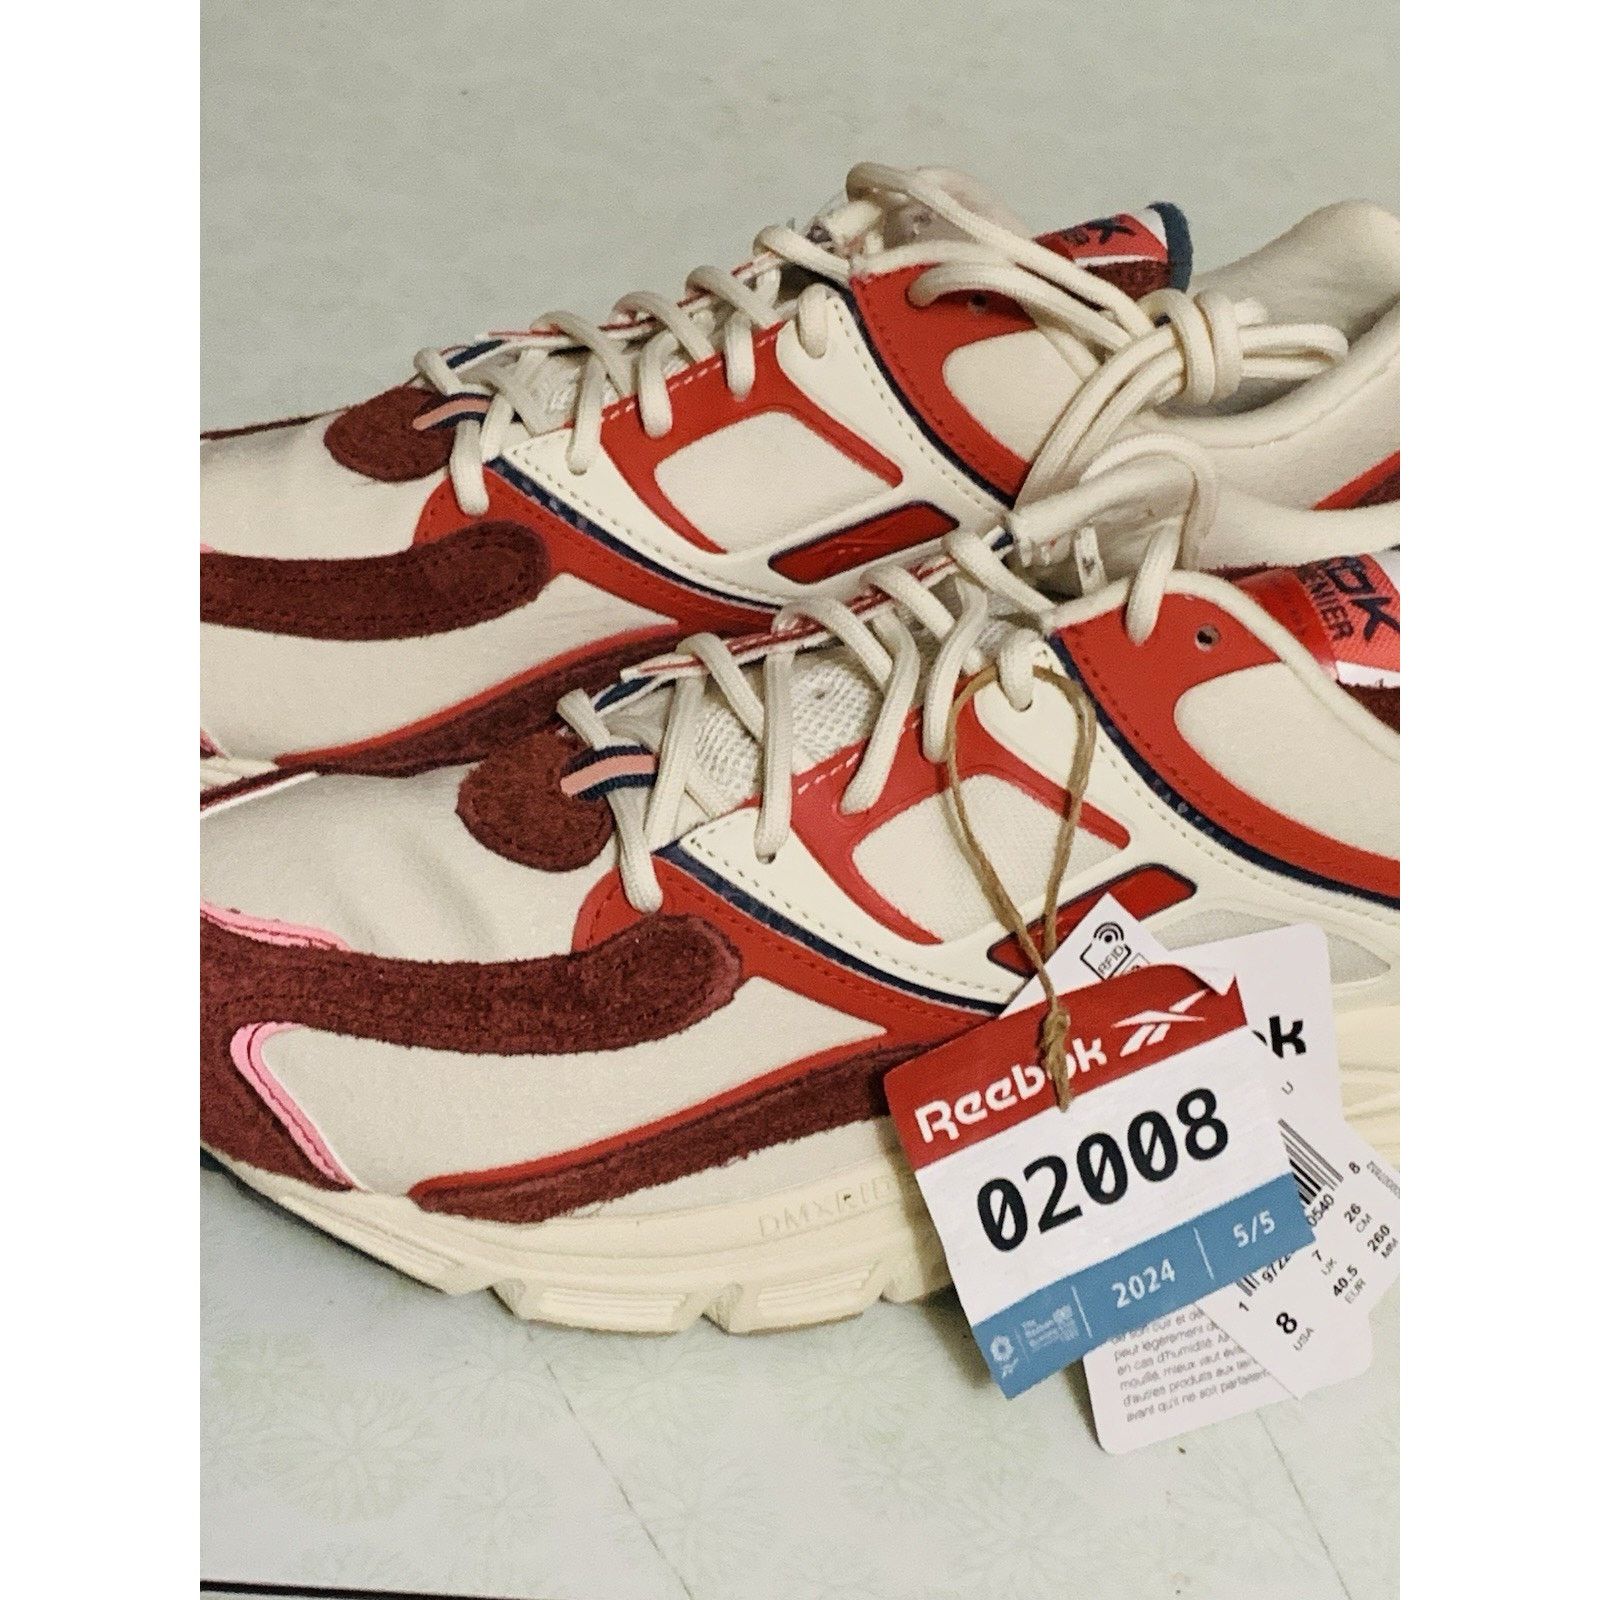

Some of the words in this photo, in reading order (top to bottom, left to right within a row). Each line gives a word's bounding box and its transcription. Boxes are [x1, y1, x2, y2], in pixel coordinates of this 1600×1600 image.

[1098, 944, 1125, 974] RFID
[977, 1087, 1229, 1253] 02008
[1343, 1202, 1362, 1224] 26
[1355, 1213, 1373, 1234] CM
[1232, 1209, 1276, 1249] 5/5
[1239, 1301, 1250, 1313] 1
[1348, 1160, 1361, 1174] 8
[1366, 1223, 1391, 1253] 260
[1311, 1249, 1323, 1263] 7
[1321, 1258, 1338, 1277] UK
[1111, 1258, 1176, 1309] 2024
[1332, 1264, 1359, 1297] 40.5
[1344, 1277, 1367, 1305] EUR
[1275, 1311, 1298, 1334] 8
[1292, 1326, 1315, 1352] USA
[1114, 1342, 1139, 1362] peut
[1163, 1360, 1196, 1377] mieux
[1200, 1352, 1220, 1367] vaut
[1117, 1365, 1132, 1376] en
[1134, 1356, 1154, 1371] cas
[1182, 1392, 1196, 1403] ne
